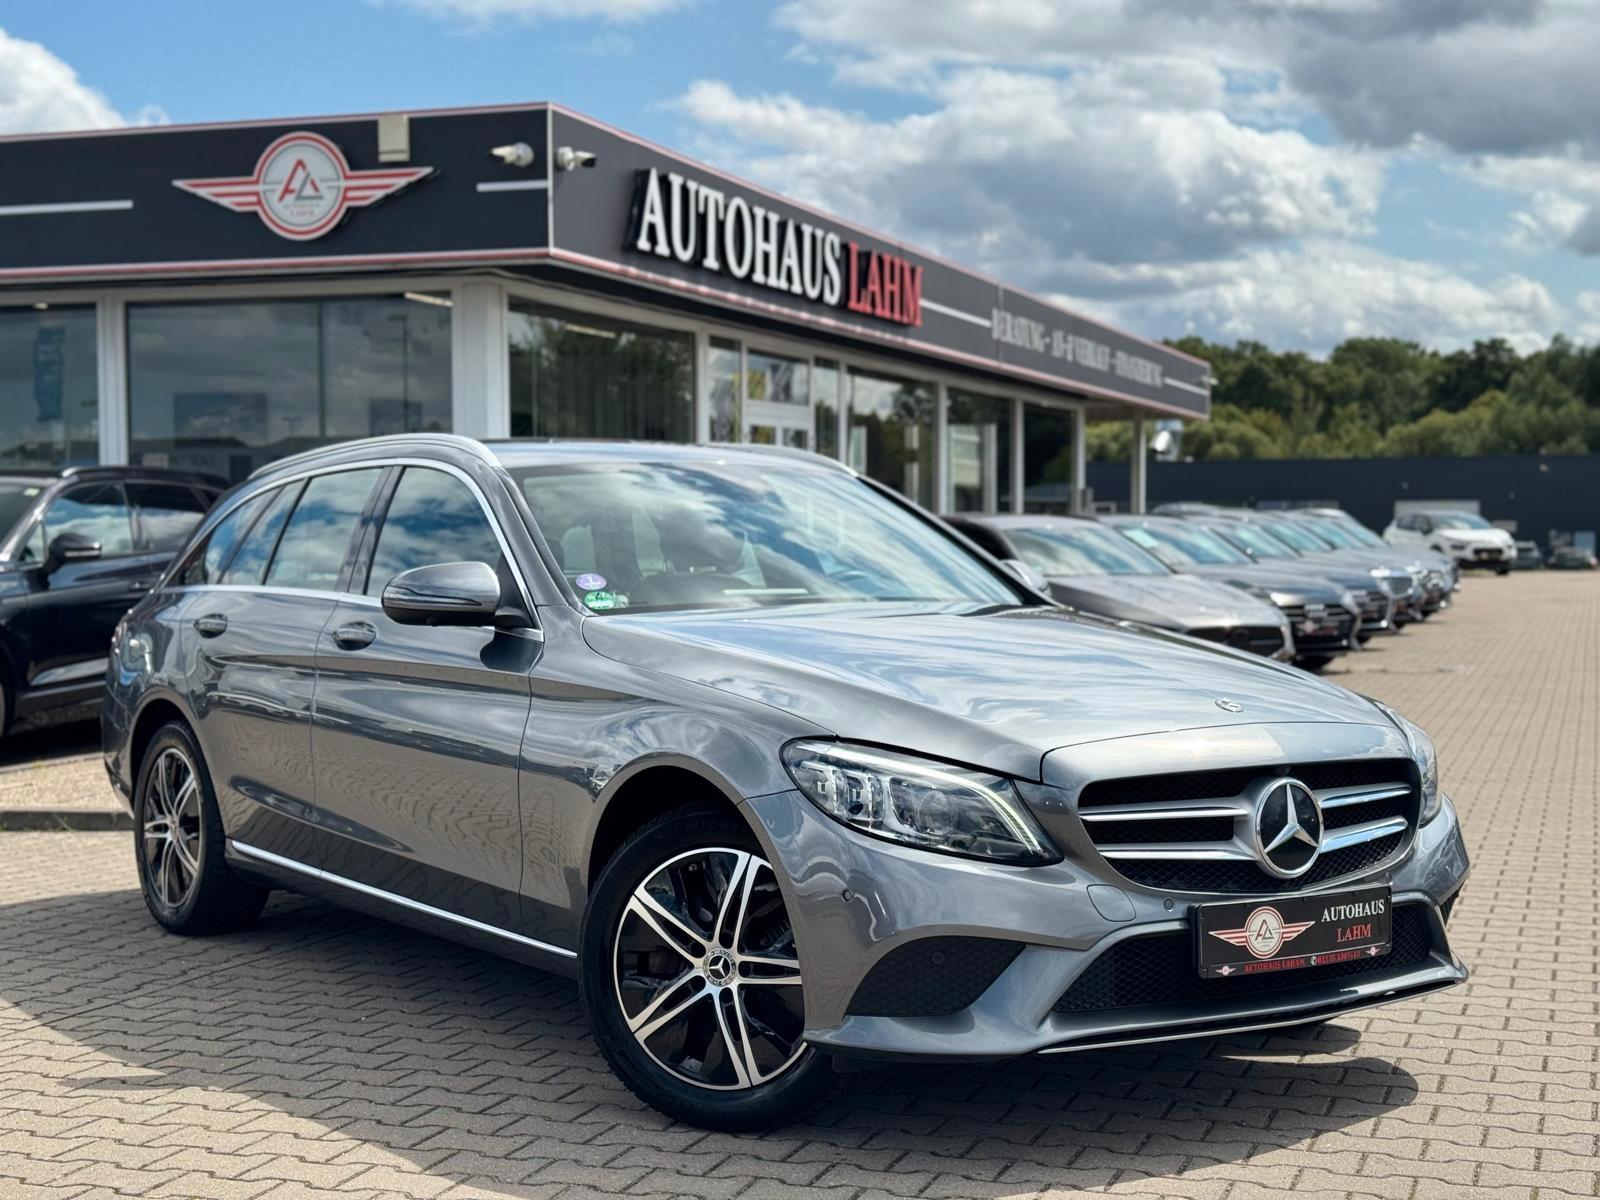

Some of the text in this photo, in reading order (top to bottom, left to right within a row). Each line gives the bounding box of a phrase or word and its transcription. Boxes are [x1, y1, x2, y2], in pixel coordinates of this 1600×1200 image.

[637, 167, 924, 328] AUTOHAUS LAHM
[1321, 899, 1385, 922] AUTOHAUS
[1336, 924, 1371, 942] LAHM
